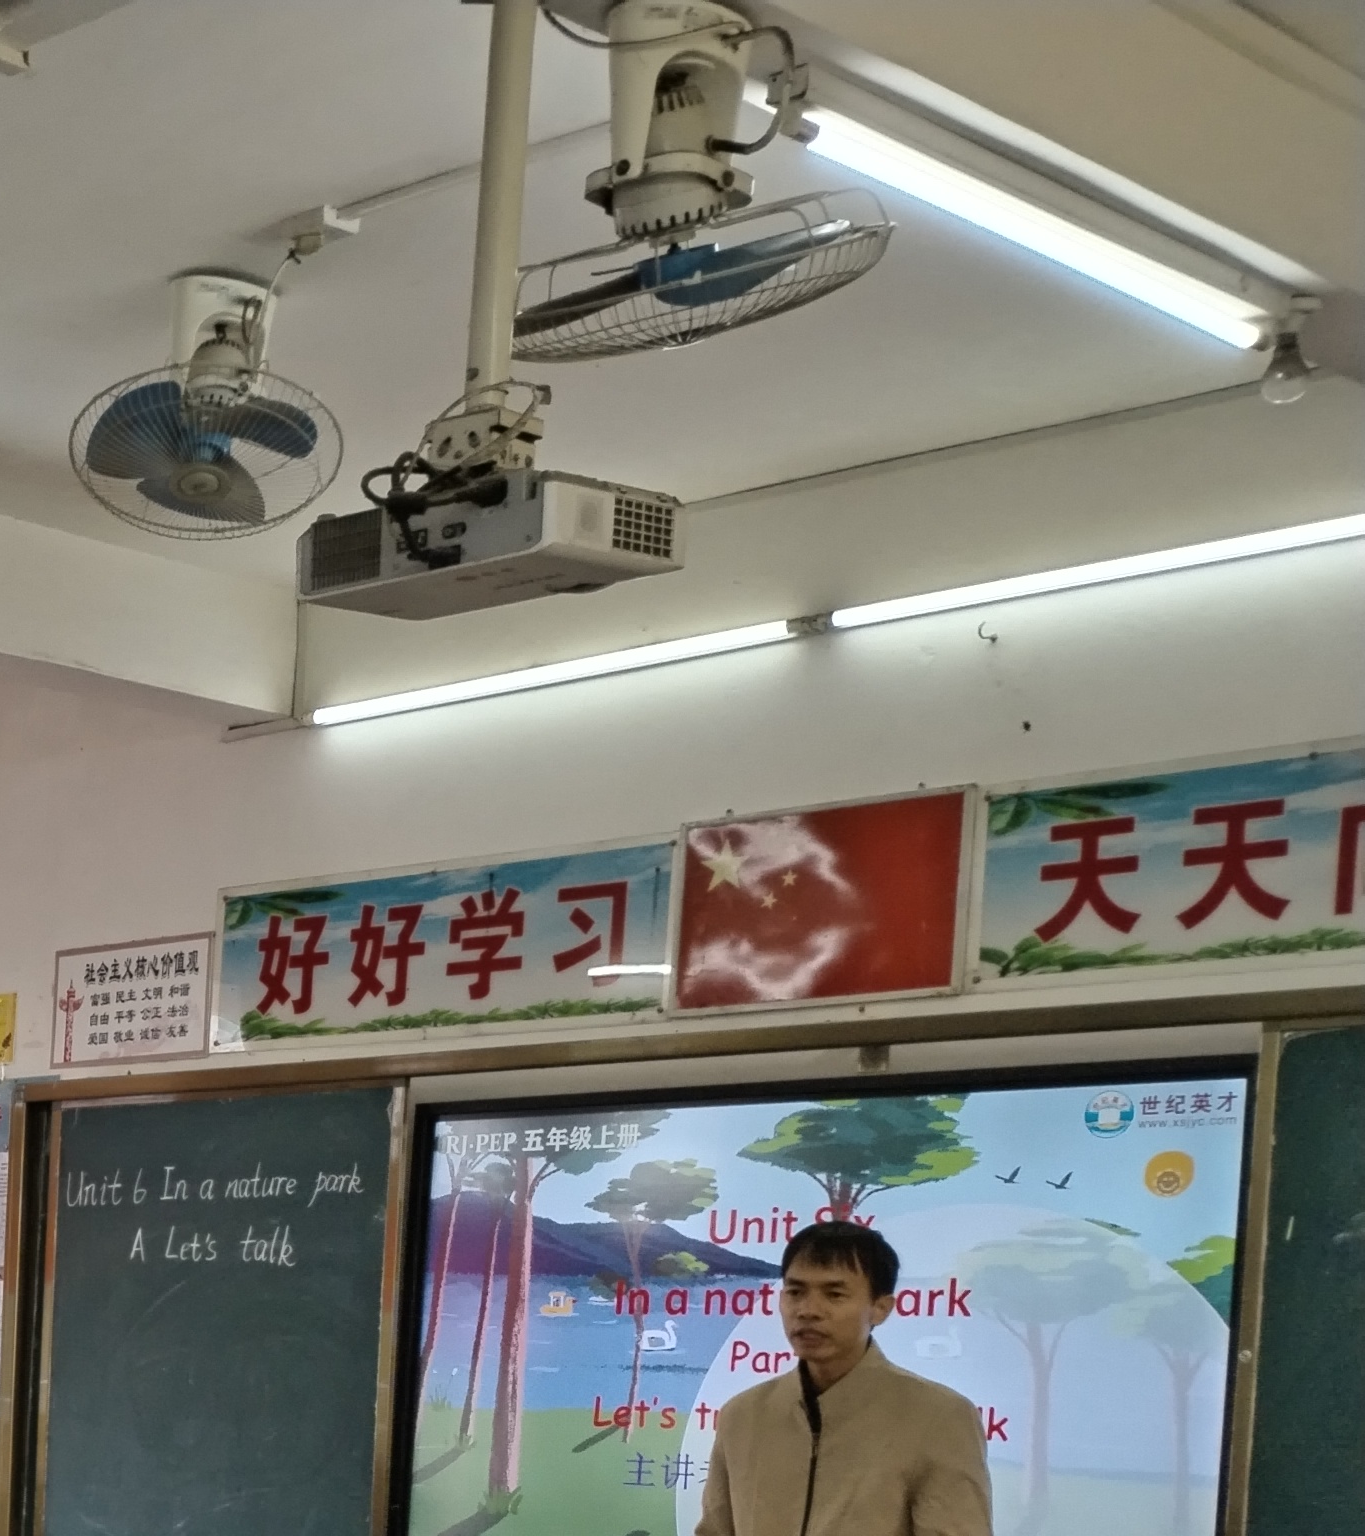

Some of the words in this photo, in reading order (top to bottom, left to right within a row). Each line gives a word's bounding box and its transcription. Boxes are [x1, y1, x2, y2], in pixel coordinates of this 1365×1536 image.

[257, 880, 628, 1016] 好好学习
[84, 950, 200, 985] 社会主义核心价值观
[115, 989, 137, 1003] 民主
[141, 986, 163, 1000] 文明
[168, 983, 190, 998] 和谐
[90, 1012, 109, 1026] 自由
[140, 1006, 162, 1020] 公正
[167, 1004, 189, 1017] 法治
[87, 1031, 108, 1045] 爱国
[166, 1024, 188, 1037] 友善
[1139, 1092, 1238, 1116] 世纪英才
[522, 1123, 641, 1151] 五年级上册
[66, 1168, 121, 1207] Unit
[133, 1168, 147, 1205] 6
[160, 1166, 189, 1201] In
[199, 1178, 214, 1201] a
[225, 1161, 297, 1199] nature
[307, 1162, 365, 1208] park
[709, 1207, 798, 1245] Unit
[129, 1227, 145, 1262] A
[165, 1225, 217, 1261] Let's
[240, 1225, 296, 1267] talk
[615, 1279, 650, 1316] In
[664, 1289, 689, 1316] a
[895, 1277, 972, 1317] ark
[730, 1340, 791, 1374] Par
[593, 1395, 677, 1429] Let's
